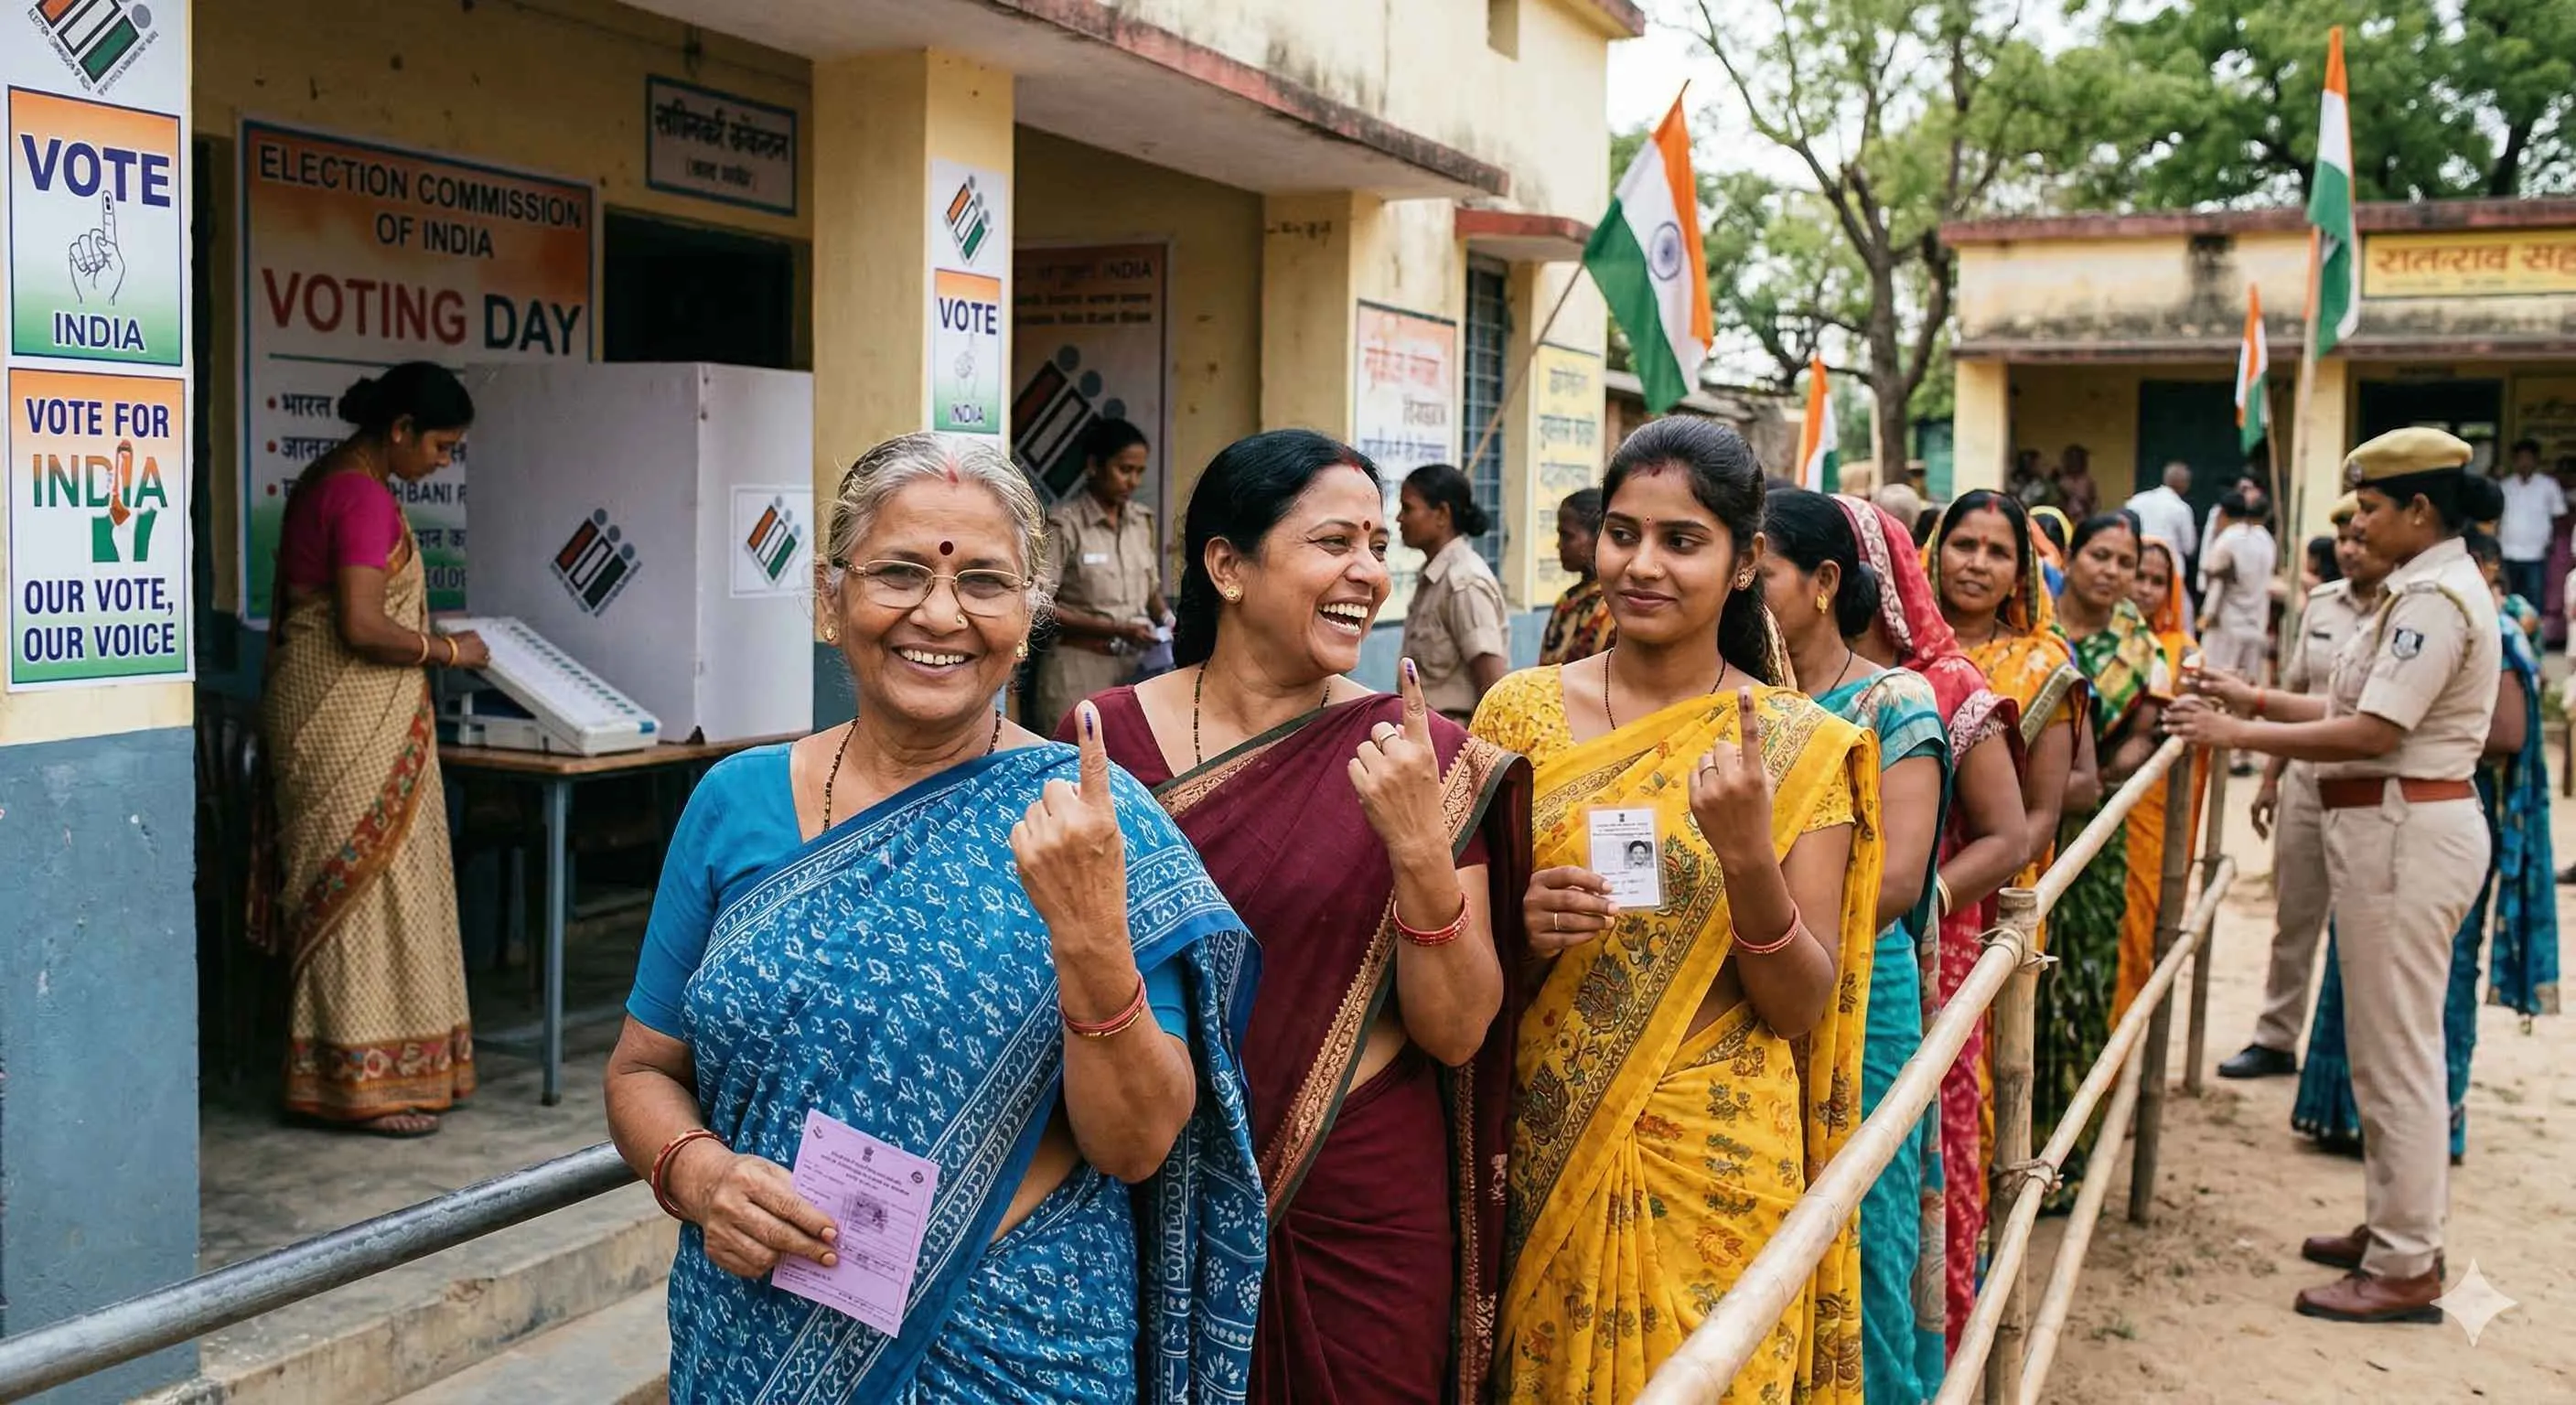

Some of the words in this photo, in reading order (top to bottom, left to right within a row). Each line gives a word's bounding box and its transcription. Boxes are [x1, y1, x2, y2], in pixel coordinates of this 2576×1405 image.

[20, 134, 171, 209] VOTE
[260, 145, 409, 201] ELECTION
[417, 173, 584, 230] COMMISSION
[376, 212, 414, 248] OF
[424, 219, 495, 259] INDIA
[55, 312, 145, 351] INDIA
[262, 268, 467, 347] VOTING
[484, 293, 583, 356] DAY
[939, 297, 997, 336] VOTE
[26, 398, 102, 436] VOTE
[114, 402, 170, 438] FOR
[281, 393, 335, 418] भारत
[950, 403, 985, 424] INDIA
[33, 453, 168, 509] INDIA
[24, 579, 85, 615] OUR
[94, 576, 175, 616] VOTE,
[24, 626, 85, 662] OUR
[94, 622, 176, 658] VOICE
